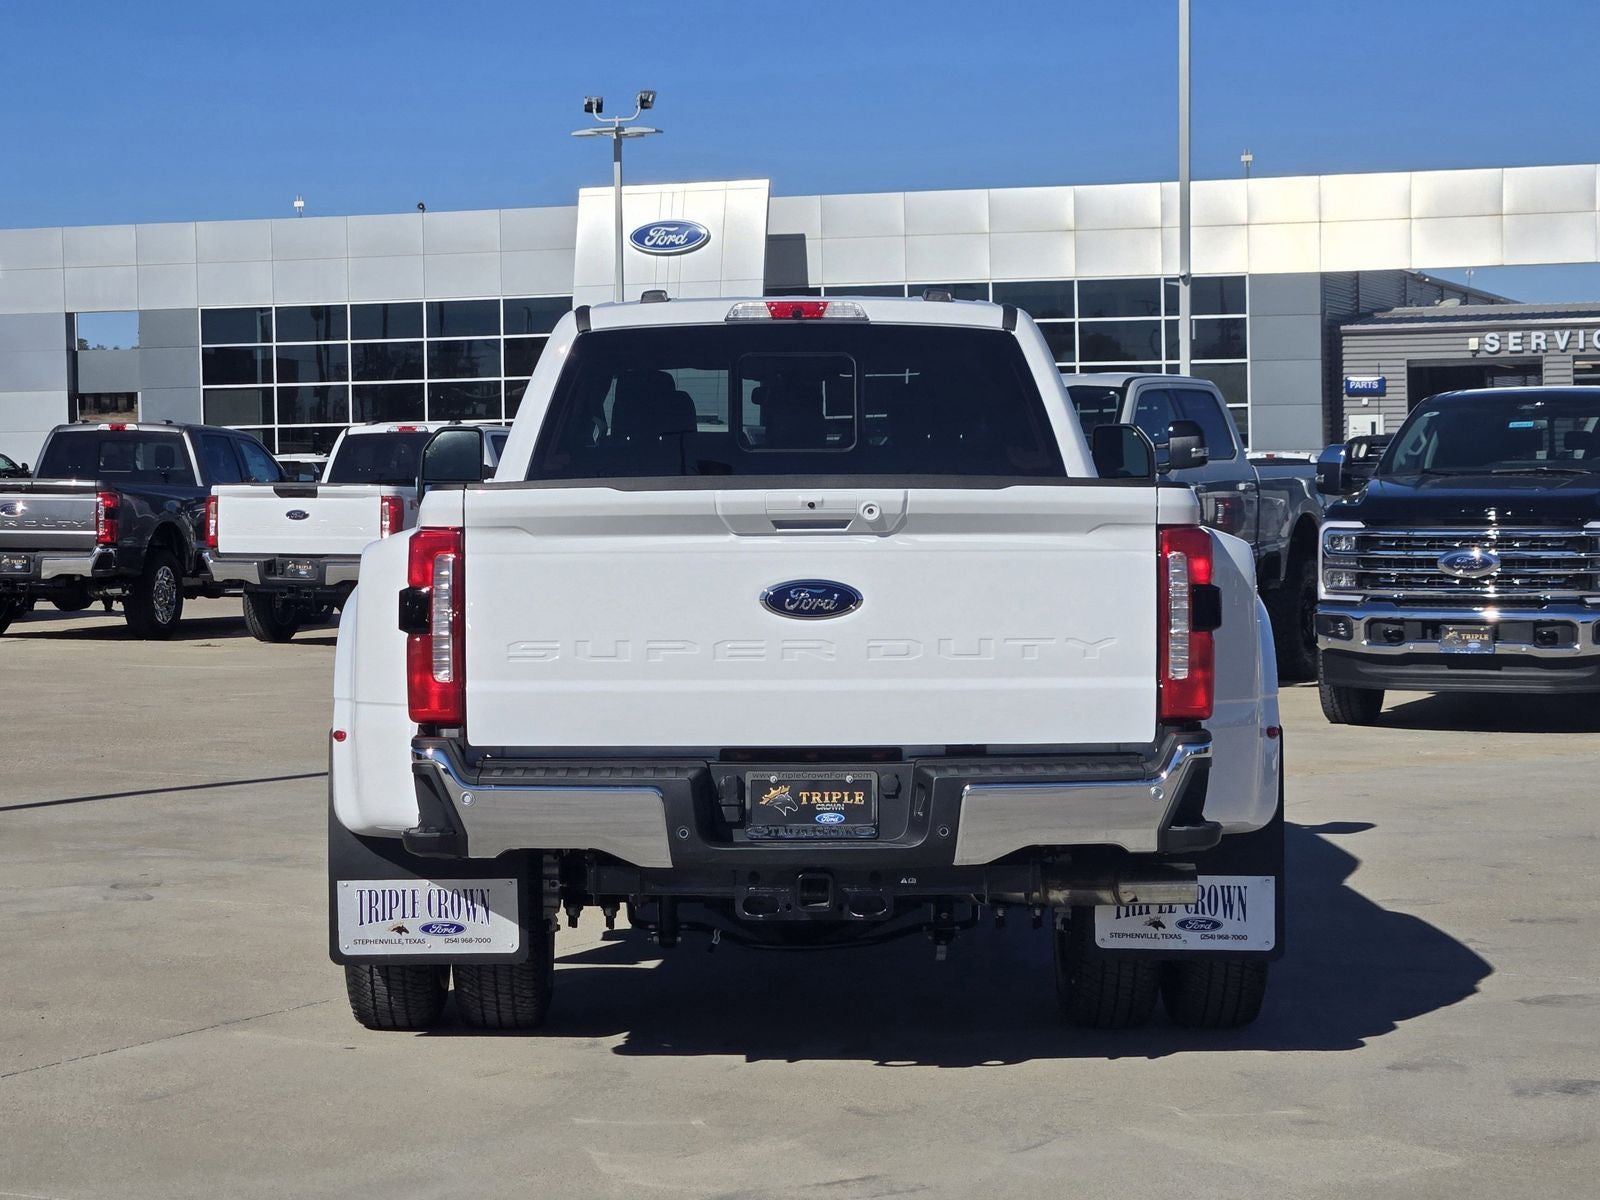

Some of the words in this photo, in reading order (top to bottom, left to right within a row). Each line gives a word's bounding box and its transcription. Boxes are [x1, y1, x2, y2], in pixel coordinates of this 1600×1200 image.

[644, 226, 689, 246] Ford
[1349, 381, 1379, 389] PARTS
[784, 587, 839, 611] Ford
[506, 639, 836, 662] SUPER
[867, 637, 1118, 661] DUTY
[799, 791, 865, 805] TRIPLE
[815, 803, 845, 811] CROWN
[356, 888, 420, 926] TRIPLE
[427, 888, 491, 925] CROWN
[428, 923, 457, 934] Ford
[1185, 919, 1213, 930] Ford
[1109, 932, 1160, 940] STEPHENVILLE,
